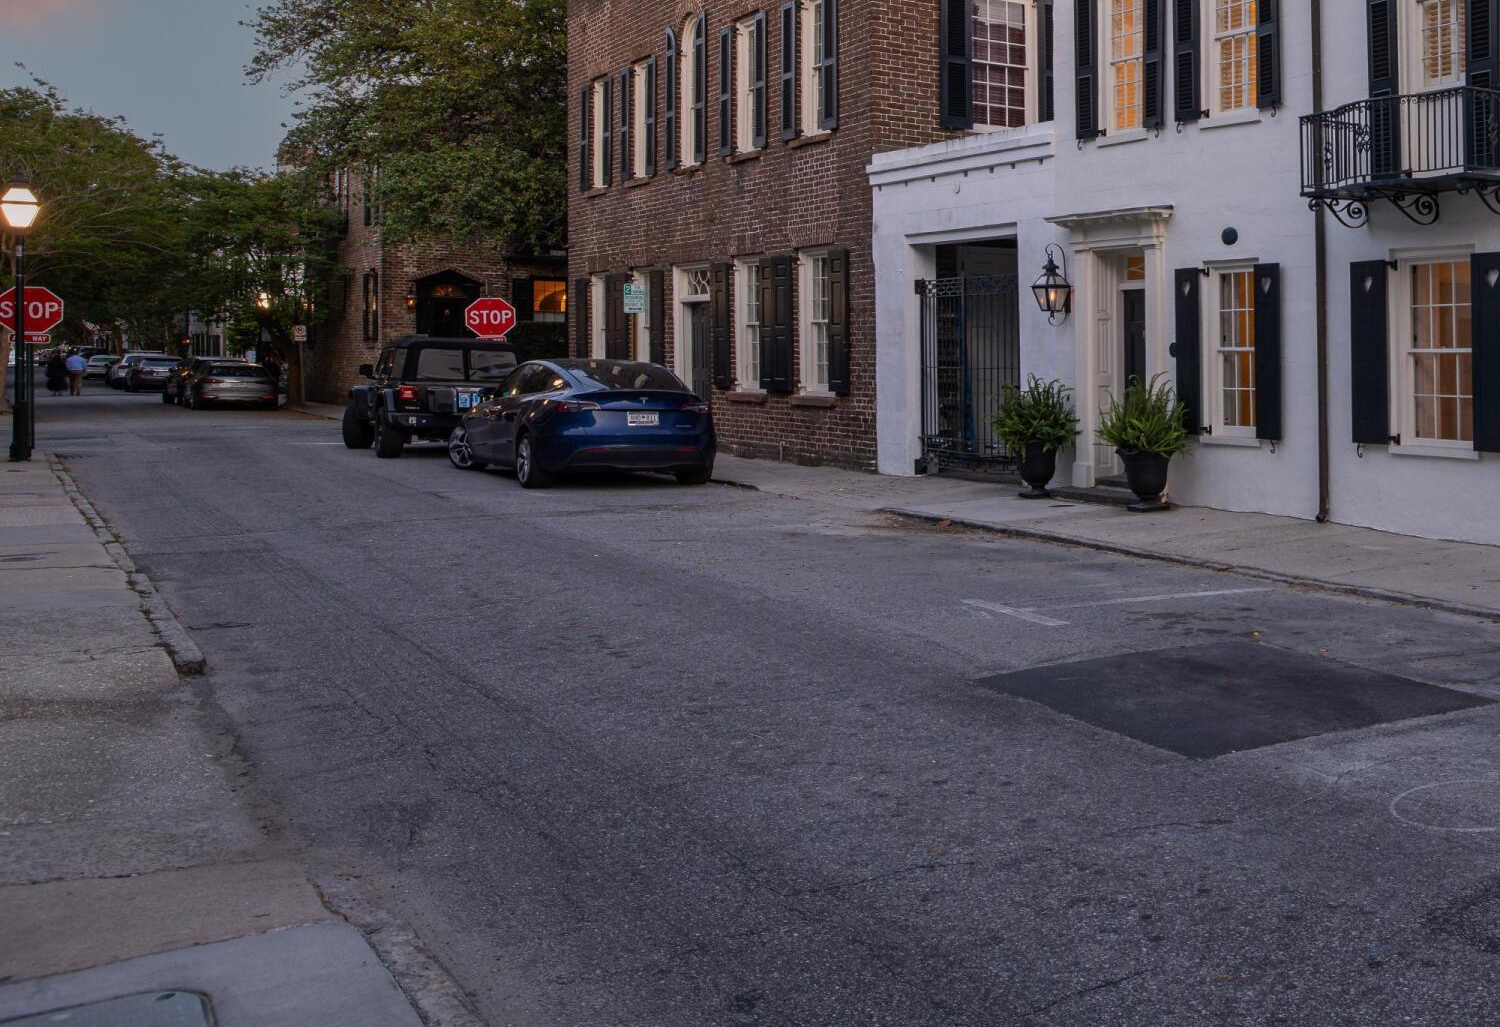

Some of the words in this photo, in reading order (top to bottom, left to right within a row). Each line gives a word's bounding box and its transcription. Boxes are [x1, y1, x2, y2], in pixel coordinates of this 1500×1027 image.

[625, 286, 631, 294] 2
[0, 301, 59, 319] SOP
[469, 310, 512, 324] STOP
